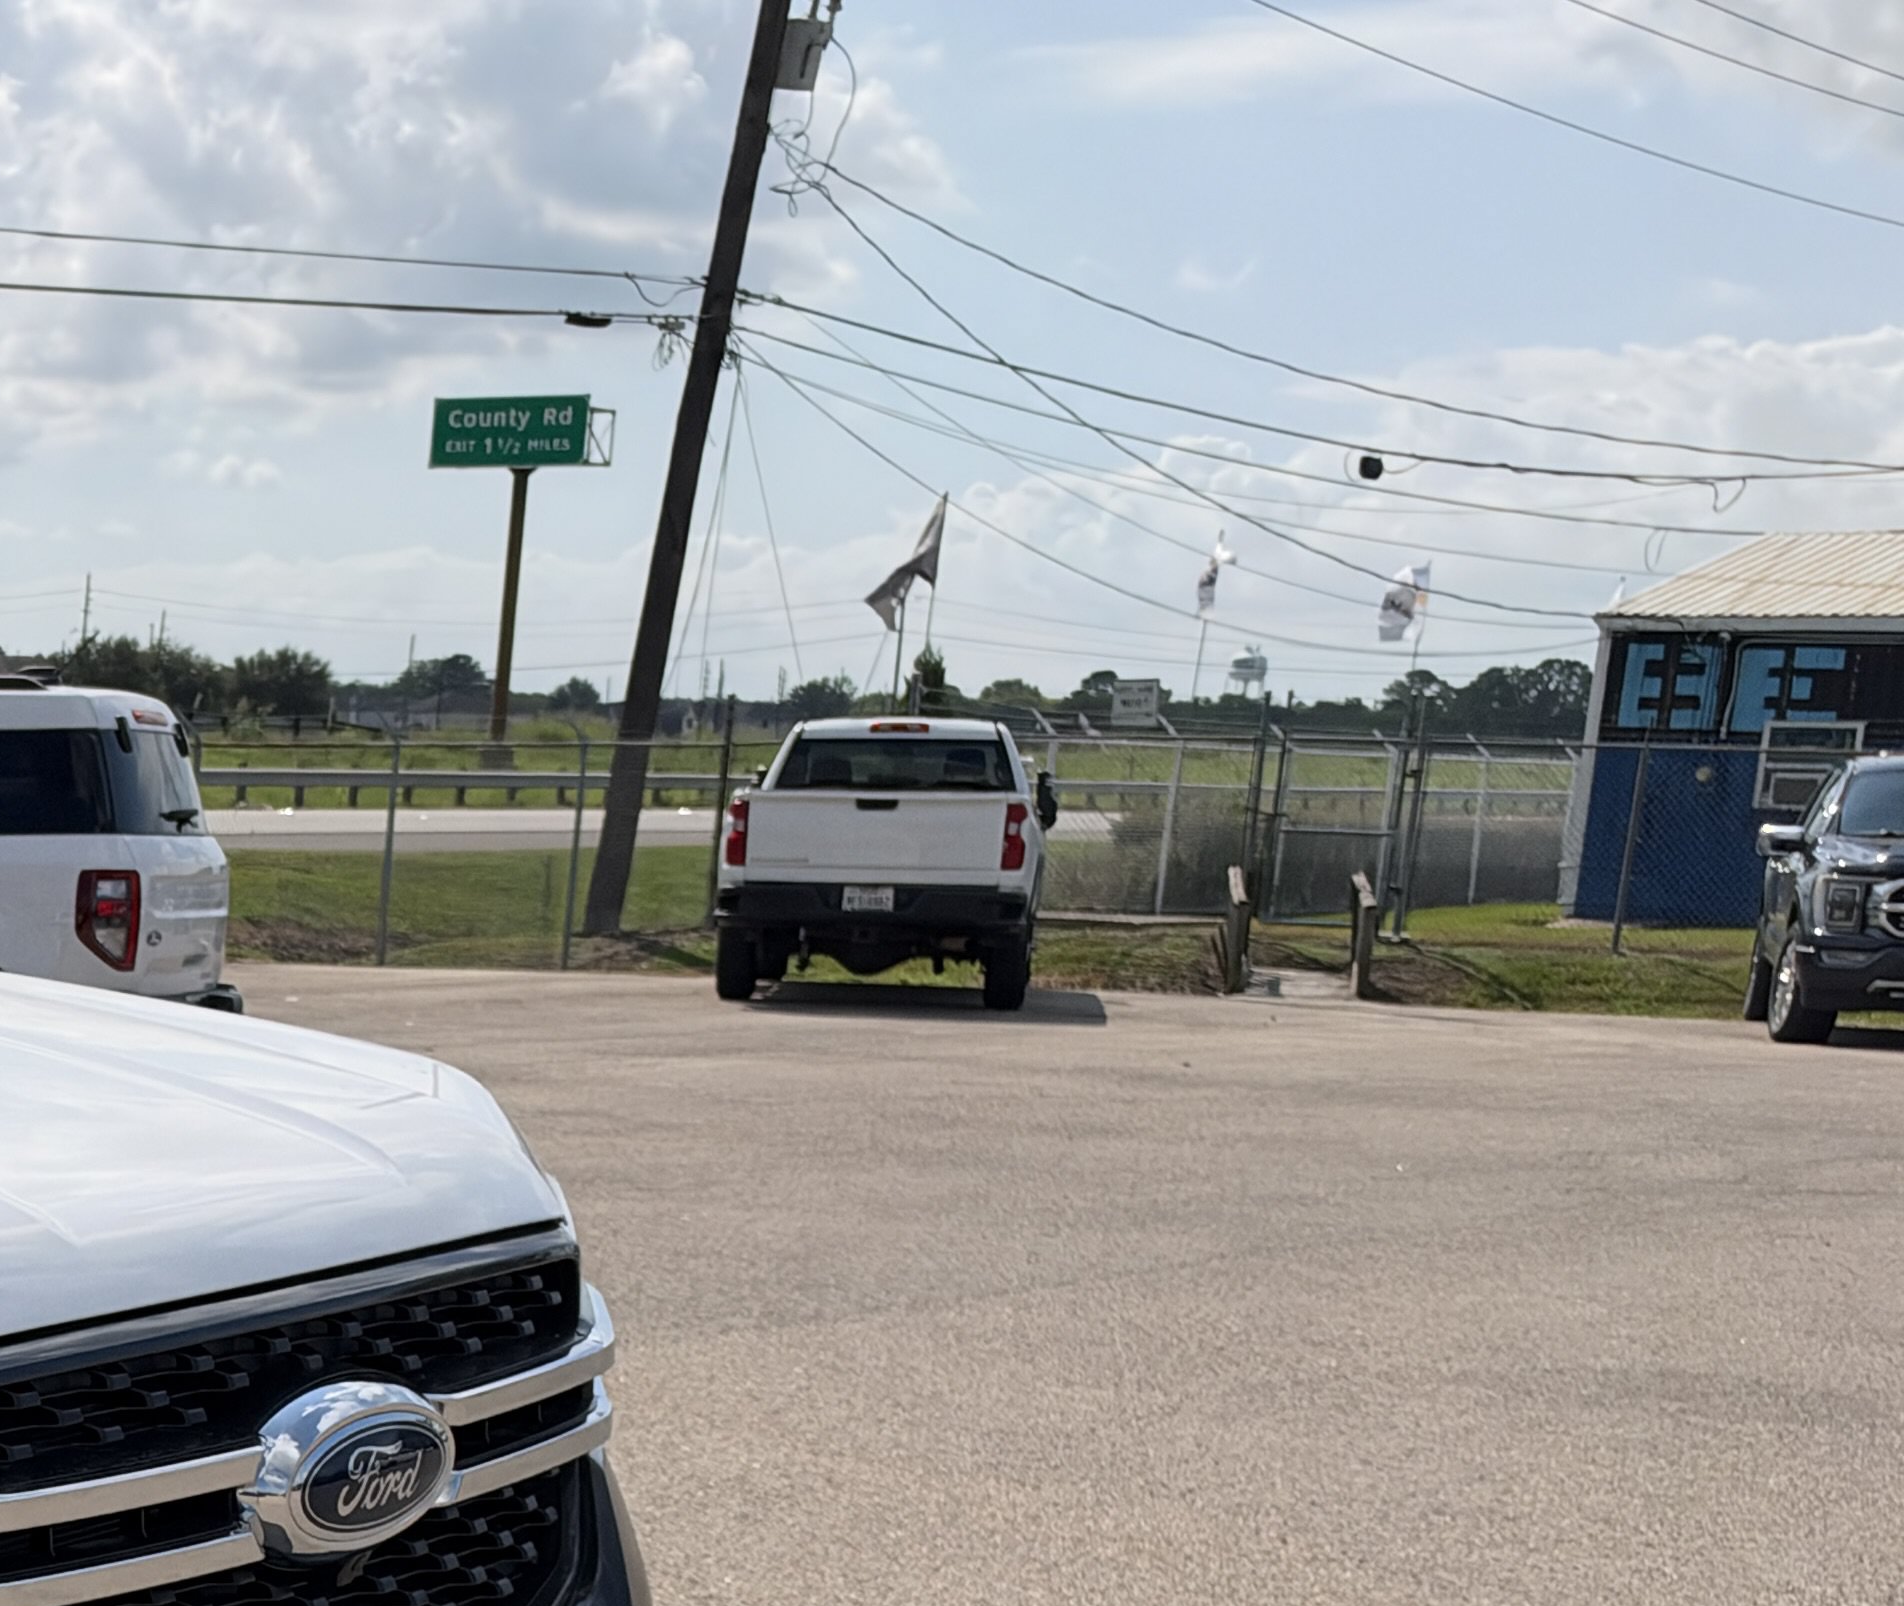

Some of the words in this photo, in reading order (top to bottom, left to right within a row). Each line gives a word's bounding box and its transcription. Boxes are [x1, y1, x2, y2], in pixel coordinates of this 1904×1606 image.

[448, 409, 531, 431] County
[544, 406, 573, 425] Rd
[445, 440, 476, 452] EXIT
[528, 438, 570, 452] MILES
[337, 1440, 423, 1517] Ford
